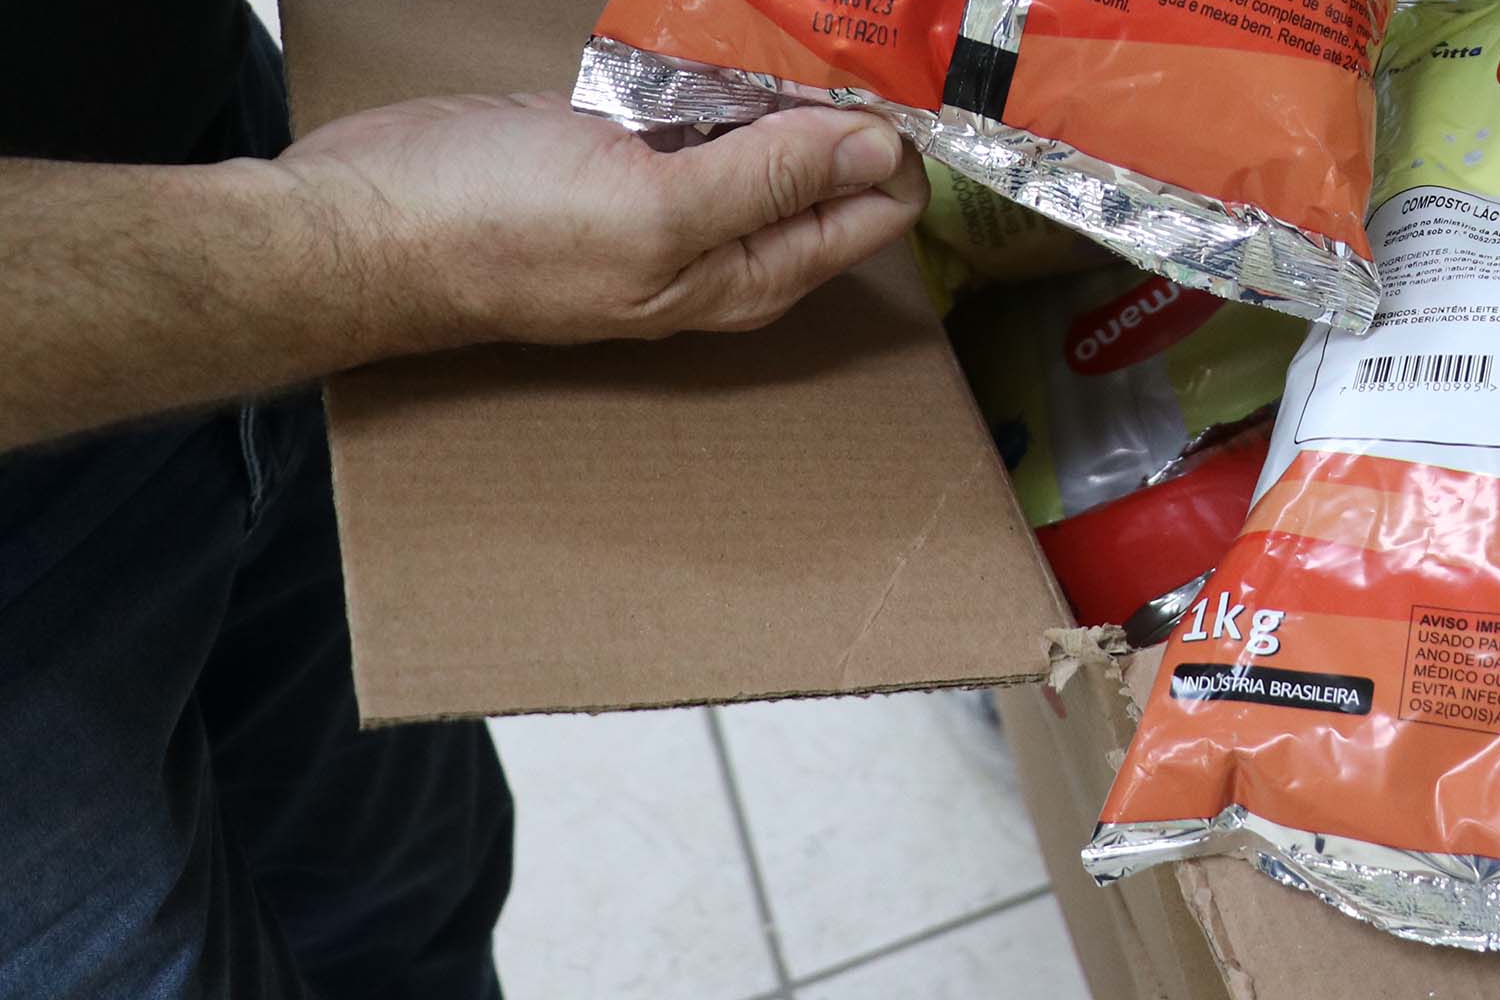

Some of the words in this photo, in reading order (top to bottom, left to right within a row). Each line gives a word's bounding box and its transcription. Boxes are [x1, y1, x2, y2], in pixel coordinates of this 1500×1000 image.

[1252, 1, 1350, 48] completamente.
[1430, 41, 1482, 59] vitta
[1401, 195, 1471, 215] COMPOSTO
[1423, 304, 1467, 315] CONTÉM
[1469, 305, 1499, 314] LEITE
[1182, 592, 1285, 656] 1kg
[1419, 614, 1468, 631] AVISO
[1418, 630, 1474, 649] USADO
[1416, 647, 1450, 663] ANO
[1413, 664, 1478, 684] MÉDICO
[1183, 674, 1265, 694] INDÚSTRIA
[1270, 681, 1360, 706] BRASILEIRA
[1411, 681, 1456, 698] EVITA
[1409, 698, 1432, 715] OS
